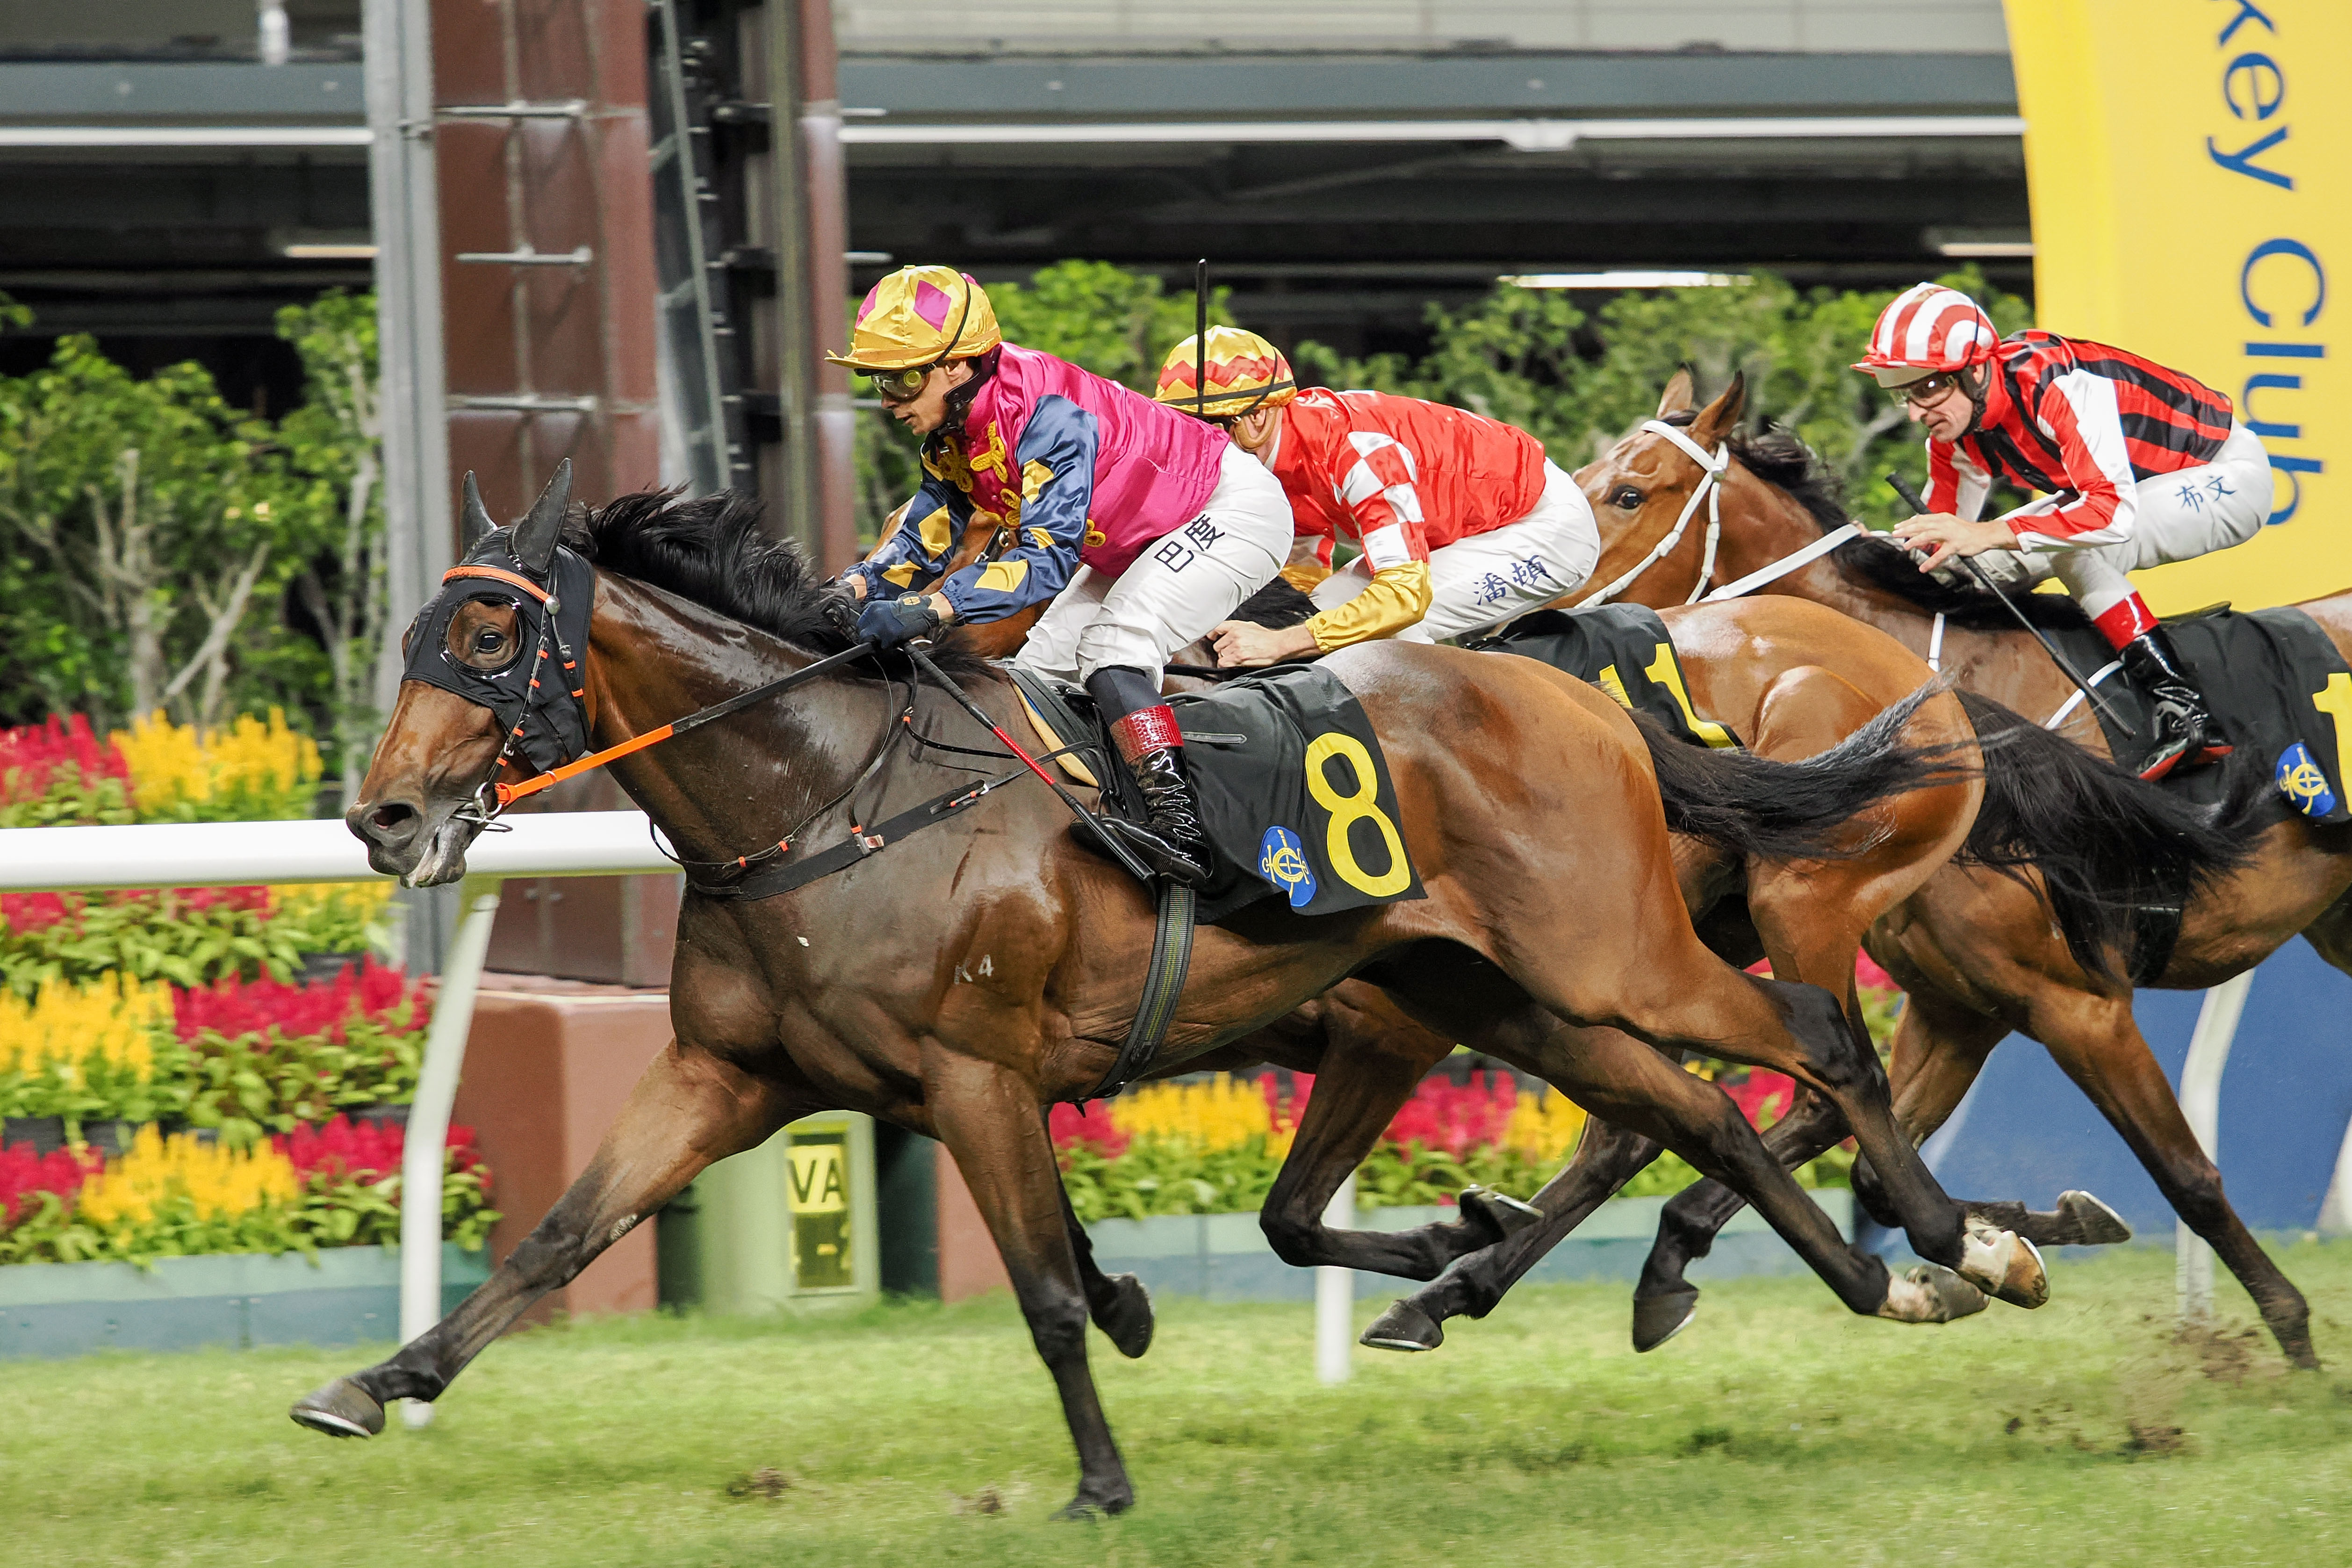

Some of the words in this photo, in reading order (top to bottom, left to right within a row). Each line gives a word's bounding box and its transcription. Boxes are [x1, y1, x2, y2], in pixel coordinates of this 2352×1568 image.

[2240, 237, 2324, 525] Club
[2175, 475, 2238, 513] 布文
[1153, 514, 1225, 573] 巴度
[1473, 554, 1551, 606] 潘頓
[1305, 732, 1411, 897] 8
